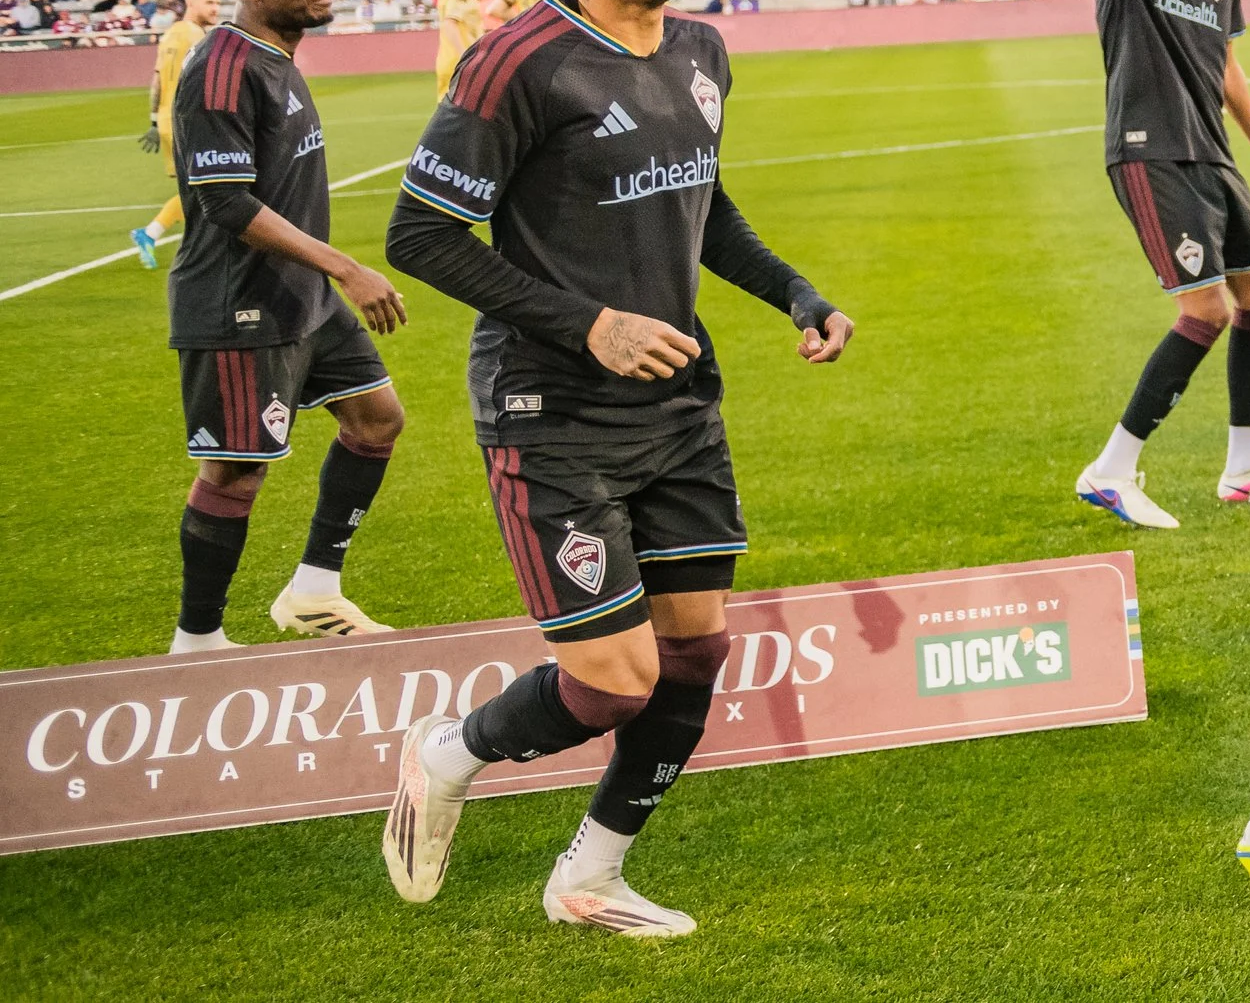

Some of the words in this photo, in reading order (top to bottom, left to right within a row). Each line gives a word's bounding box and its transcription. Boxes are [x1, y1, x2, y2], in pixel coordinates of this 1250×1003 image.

[195, 150, 252, 168] Kiewi
[411, 144, 497, 201] Kiewit
[614, 145, 718, 199] uchealth
[919, 602, 1028, 625] PRESENTED
[1037, 599, 1060, 612] BY
[923, 627, 1063, 689] DICK'S
[27, 661, 518, 773] COLORADO
[68, 742, 391, 799] START
